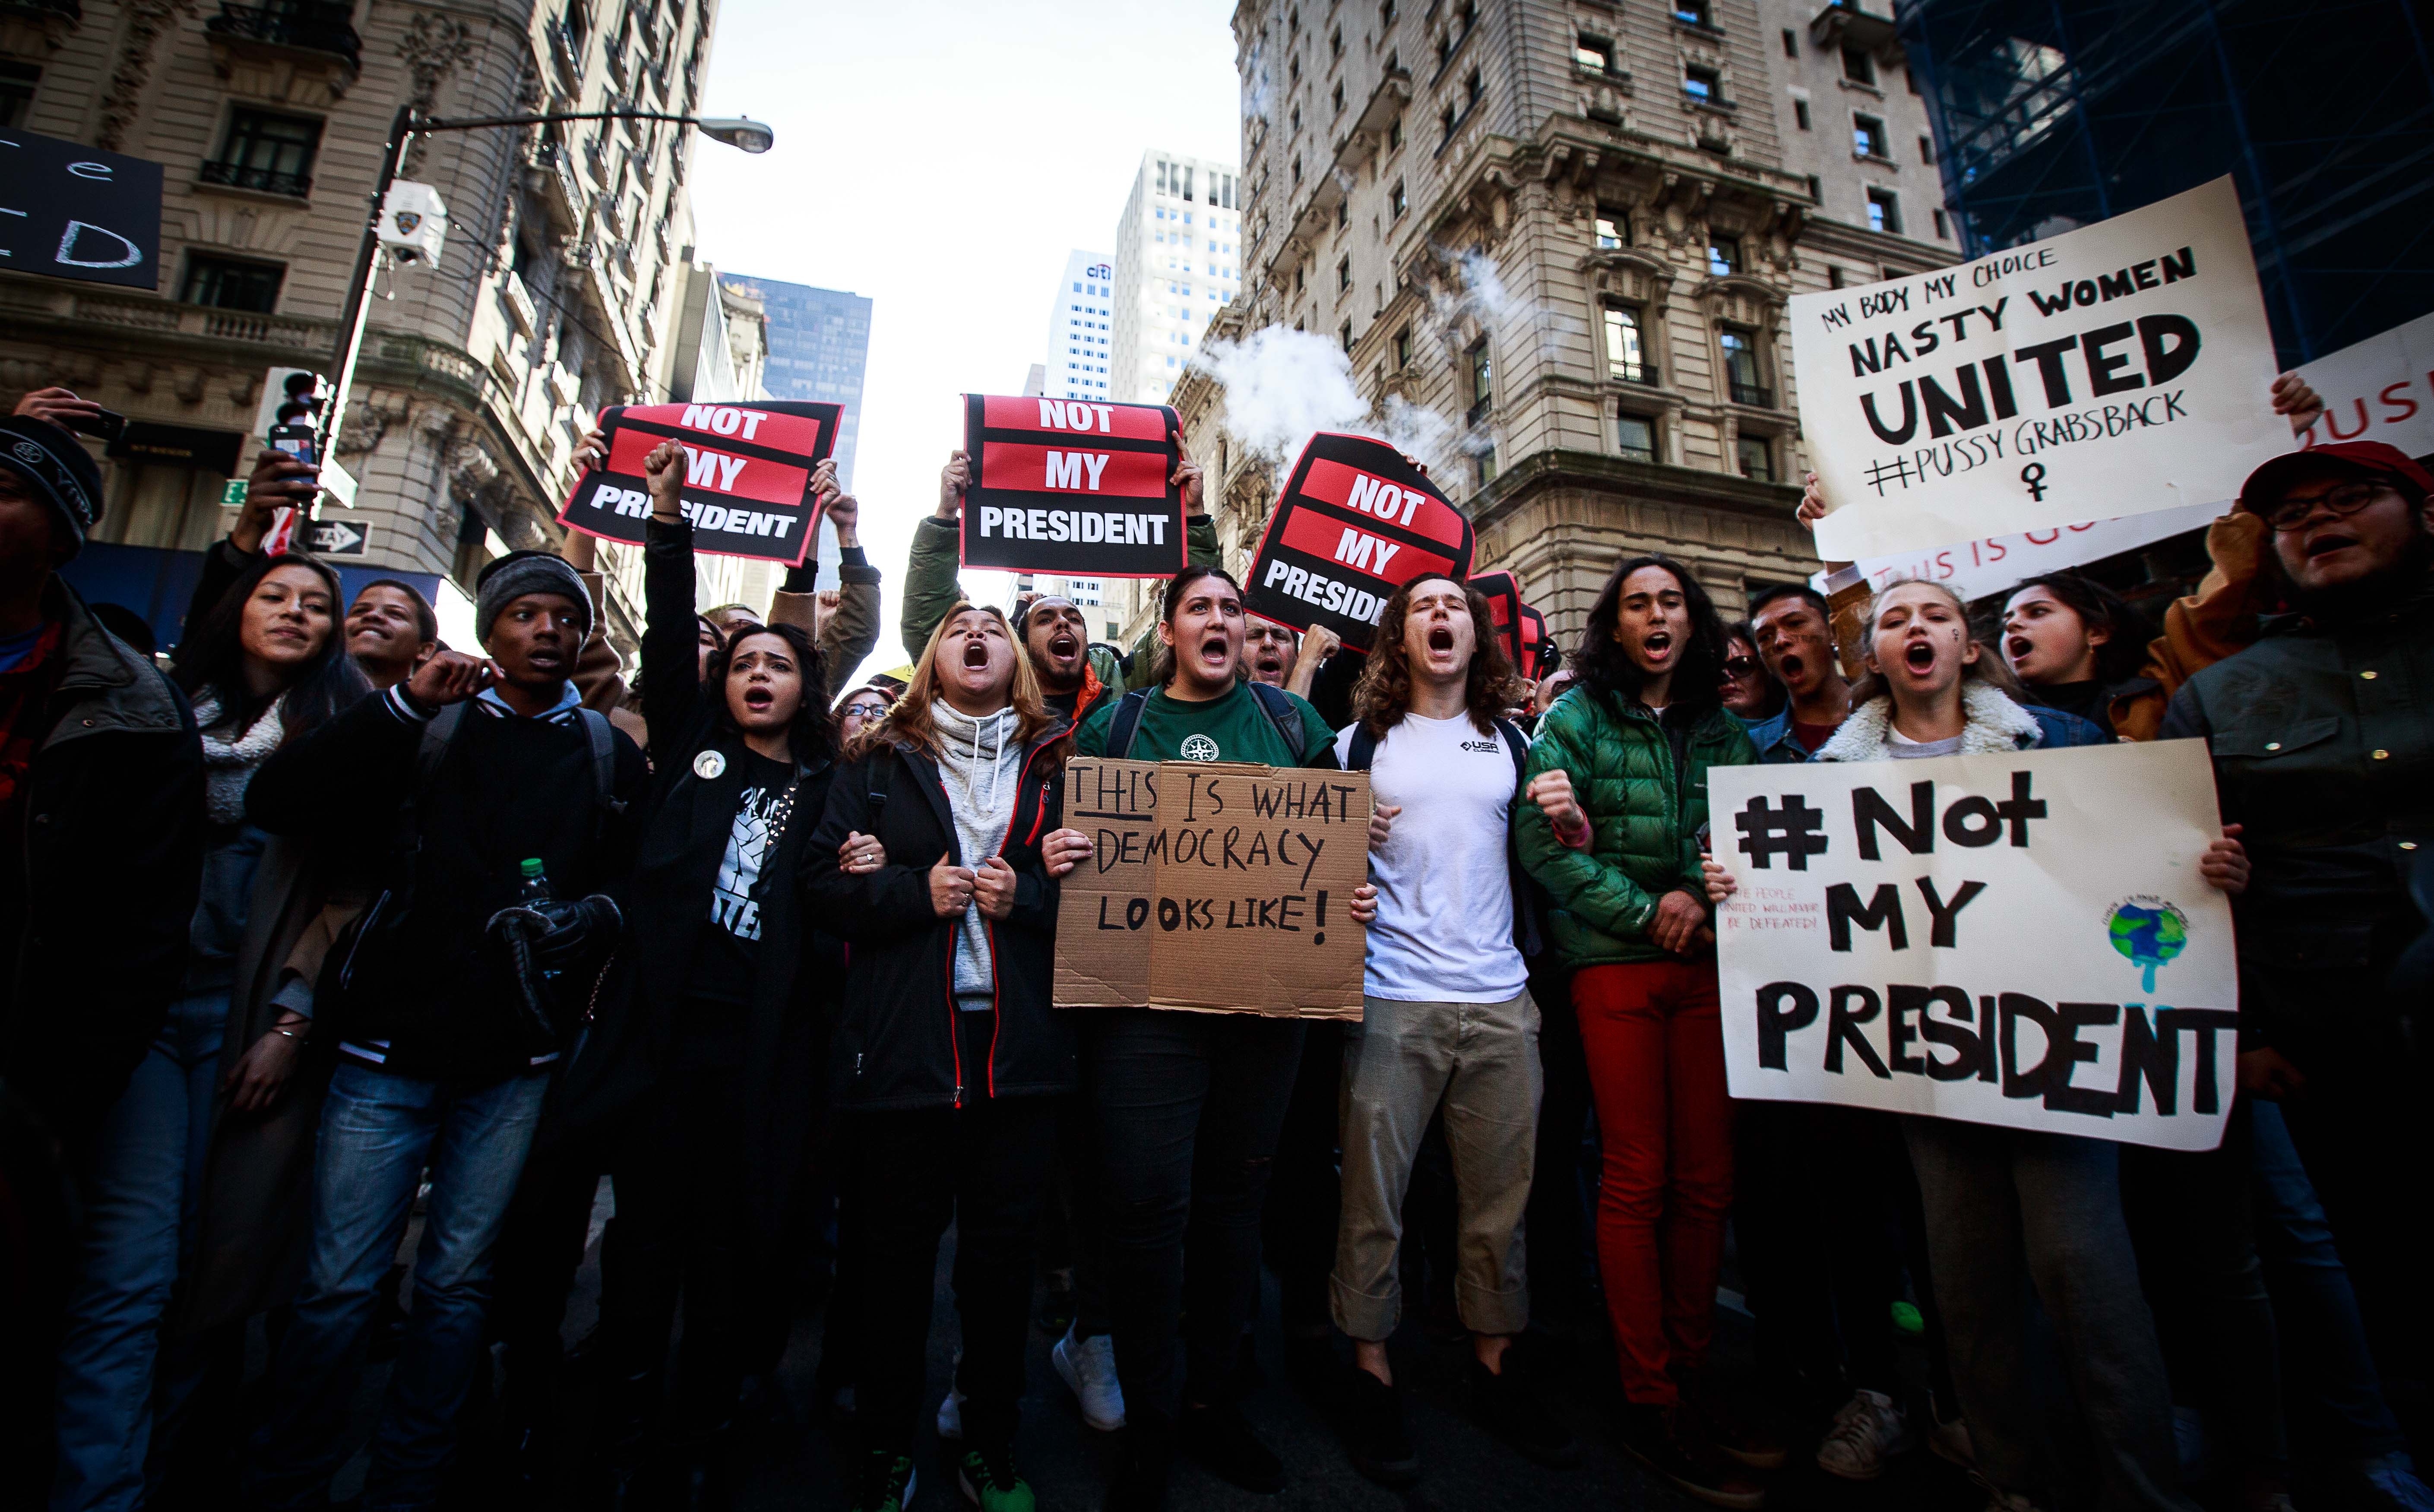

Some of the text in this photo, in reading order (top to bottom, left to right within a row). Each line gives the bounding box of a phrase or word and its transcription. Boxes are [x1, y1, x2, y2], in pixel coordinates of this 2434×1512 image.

[1087, 264, 1111, 280] citi
[1821, 247, 2059, 333] MY BODY MY CHOICE
[1848, 246, 2197, 378] NASTY WOMEN
[1858, 313, 2201, 446] UNITED
[680, 404, 767, 440] NOT
[1038, 399, 1114, 433] NOT
[687, 447, 748, 492] MY
[1045, 450, 1110, 491] MY
[980, 506, 1169, 545] PRESIDENT
[1347, 473, 1426, 527] NOT
[1334, 527, 1401, 576] MY
[1971, 538, 2007, 567] IS
[1263, 559, 1388, 627] PRESID
[1472, 741, 1499, 750] USA
[1068, 765, 1357, 824] THIS IS WHAT
[1096, 825, 1325, 891] DEMOCRACY
[1098, 889, 1329, 946] LOOKS LIKE!
[1826, 876, 1988, 952] MY
[1755, 981, 2239, 1119] PRESIDENT
